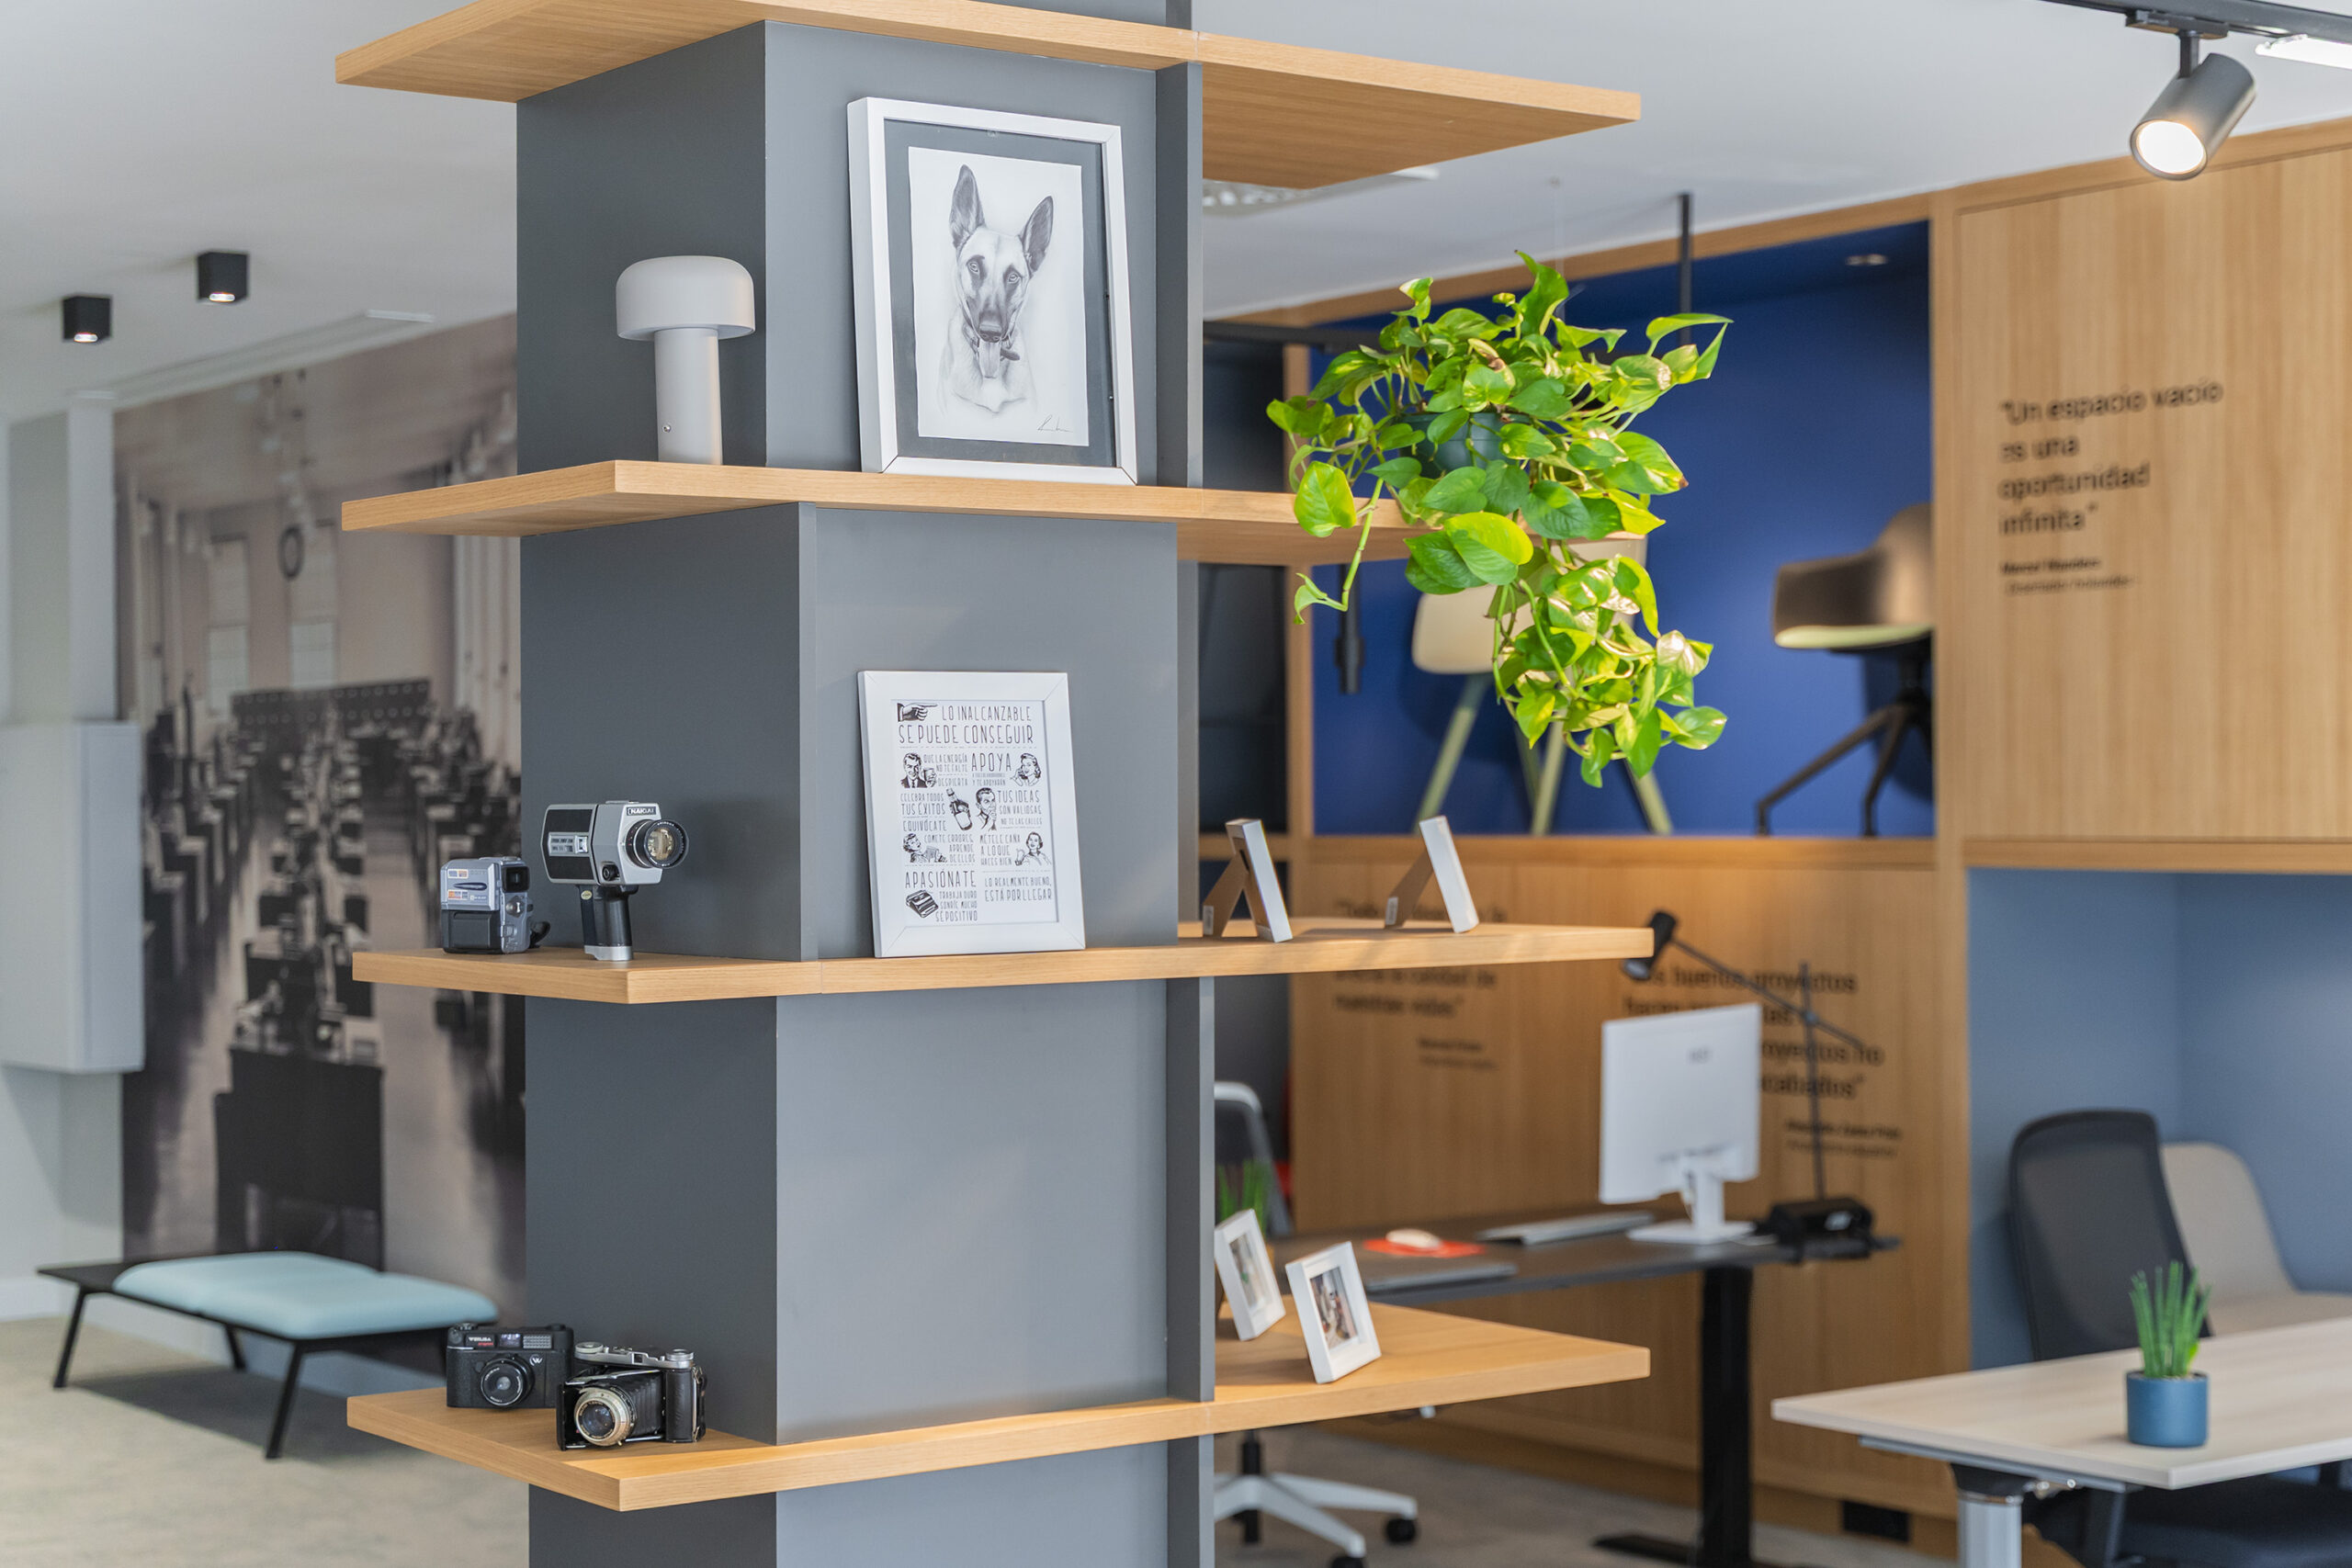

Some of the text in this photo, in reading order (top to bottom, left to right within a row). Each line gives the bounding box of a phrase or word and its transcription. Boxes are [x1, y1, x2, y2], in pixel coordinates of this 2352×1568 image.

[2046, 386, 2146, 423] espacio
[1997, 462, 2150, 502] oportunidad
[942, 705, 1032, 721] LO INALCANZABLE
[899, 724, 1034, 744] SE PUEDE CONSEGUIR
[971, 752, 1012, 772] APOYA
[899, 793, 944, 802] CELEBRA TODOS
[998, 789, 1040, 804] TUS IDEAS
[901, 802, 946, 816] TUS ÉXITOS
[999, 805, 1011, 815] SON
[902, 818, 947, 831] EQUIVÓCATE
[905, 869, 977, 889] APASIÓNATE
[984, 888, 1052, 902] ESTÁ POR LLEGAR
[935, 910, 978, 922] SE POSITIVO
